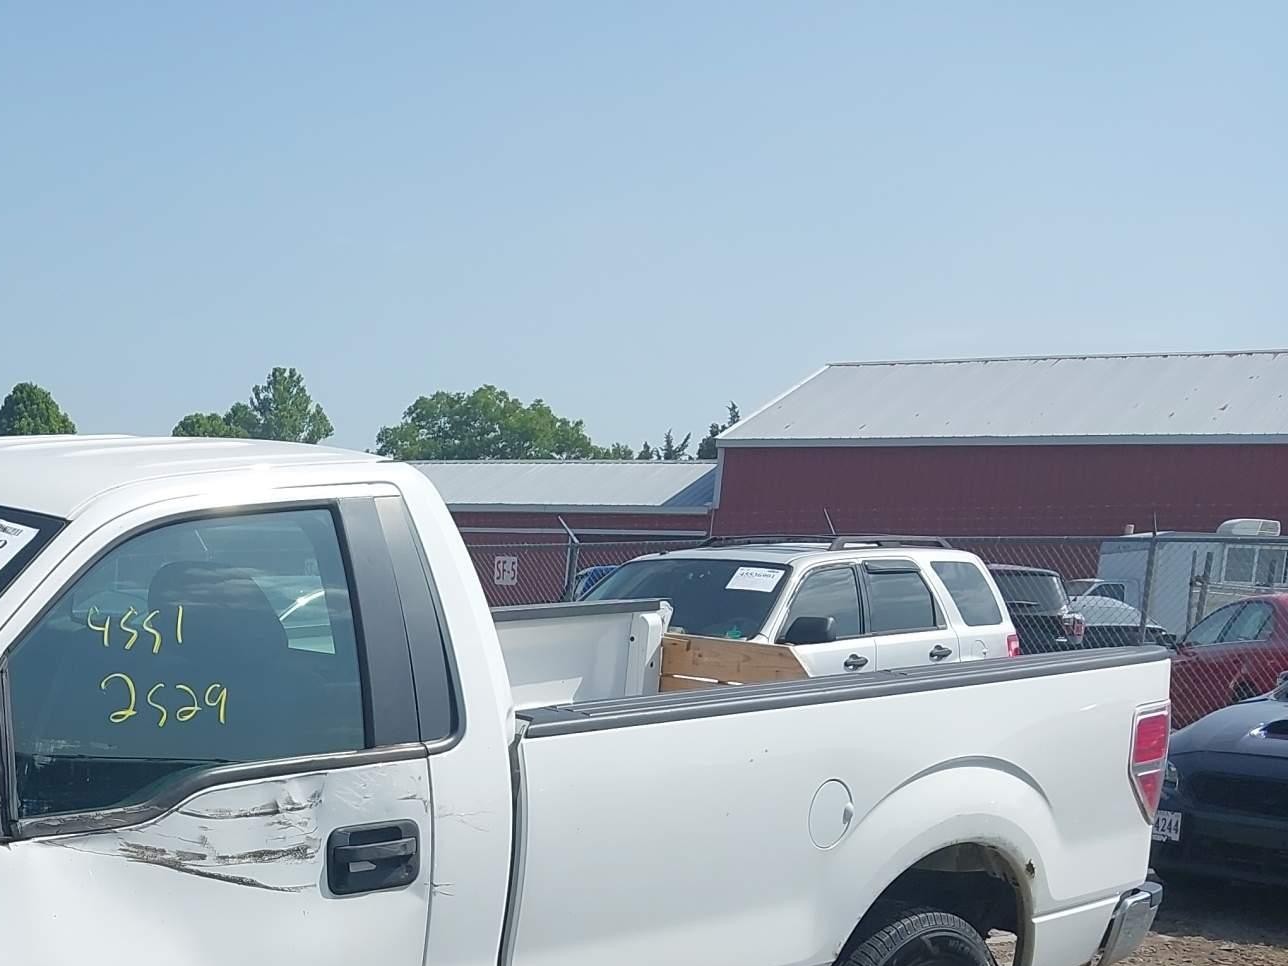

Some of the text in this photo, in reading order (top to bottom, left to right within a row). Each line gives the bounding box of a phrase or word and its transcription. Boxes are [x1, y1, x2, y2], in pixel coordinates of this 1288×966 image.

[496, 560, 516, 581] SF-5
[87, 604, 185, 655] 4551
[100, 672, 229, 728] 2529
